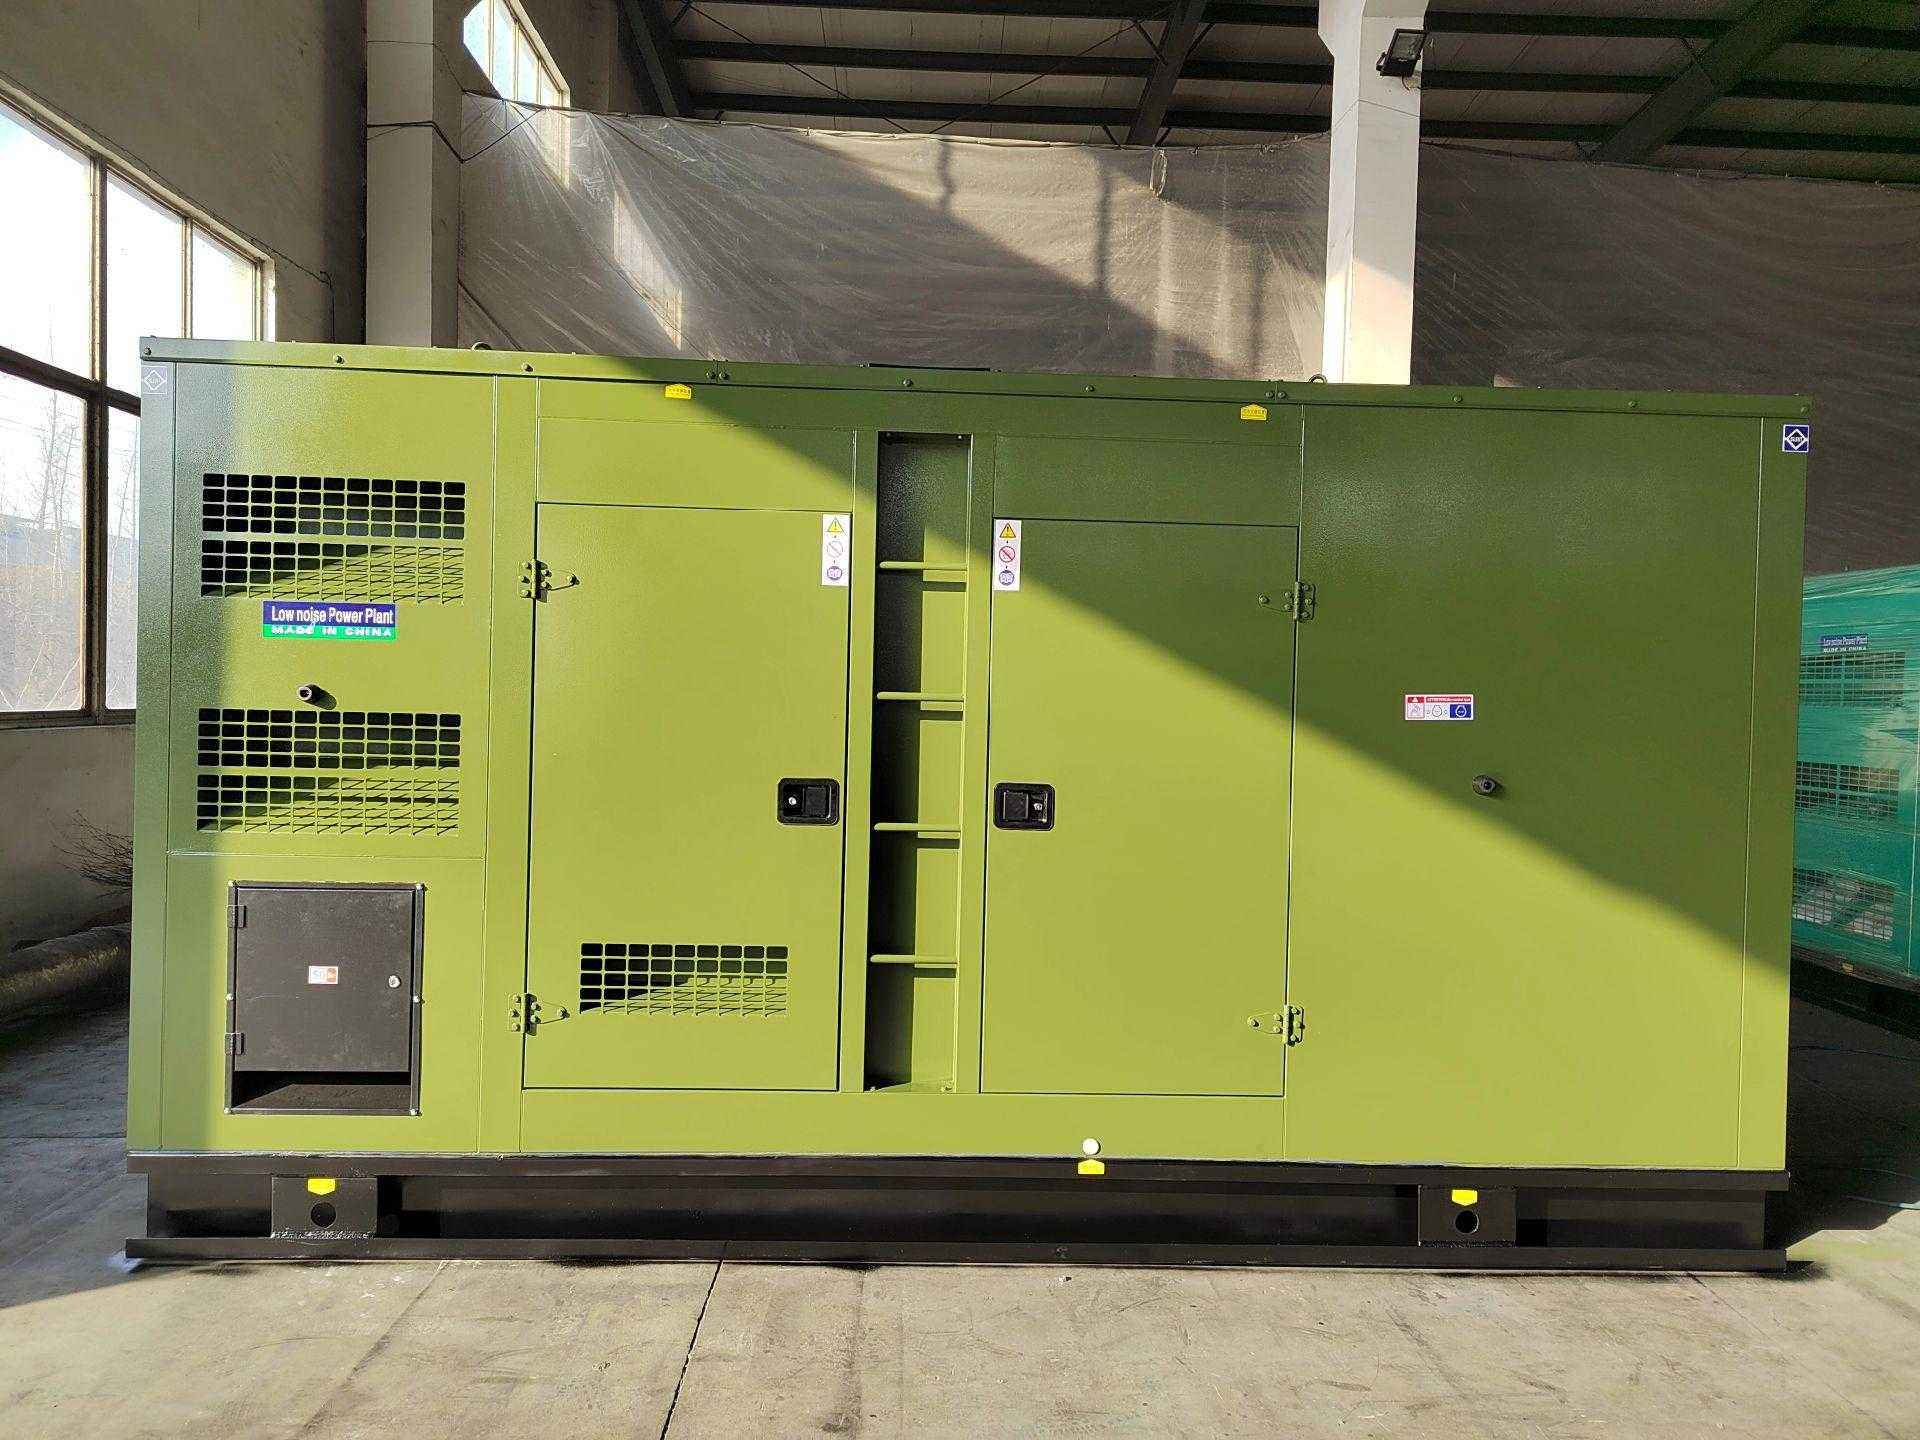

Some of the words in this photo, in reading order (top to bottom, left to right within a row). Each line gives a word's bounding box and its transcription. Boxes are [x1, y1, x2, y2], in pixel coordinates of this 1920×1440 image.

[272, 606, 294, 622] Low
[297, 607, 326, 622] noise
[329, 608, 363, 623] Power
[365, 608, 393, 624] Plant
[271, 625, 314, 635] MADE
[323, 627, 337, 635] IN
[345, 628, 392, 637] CHINA
